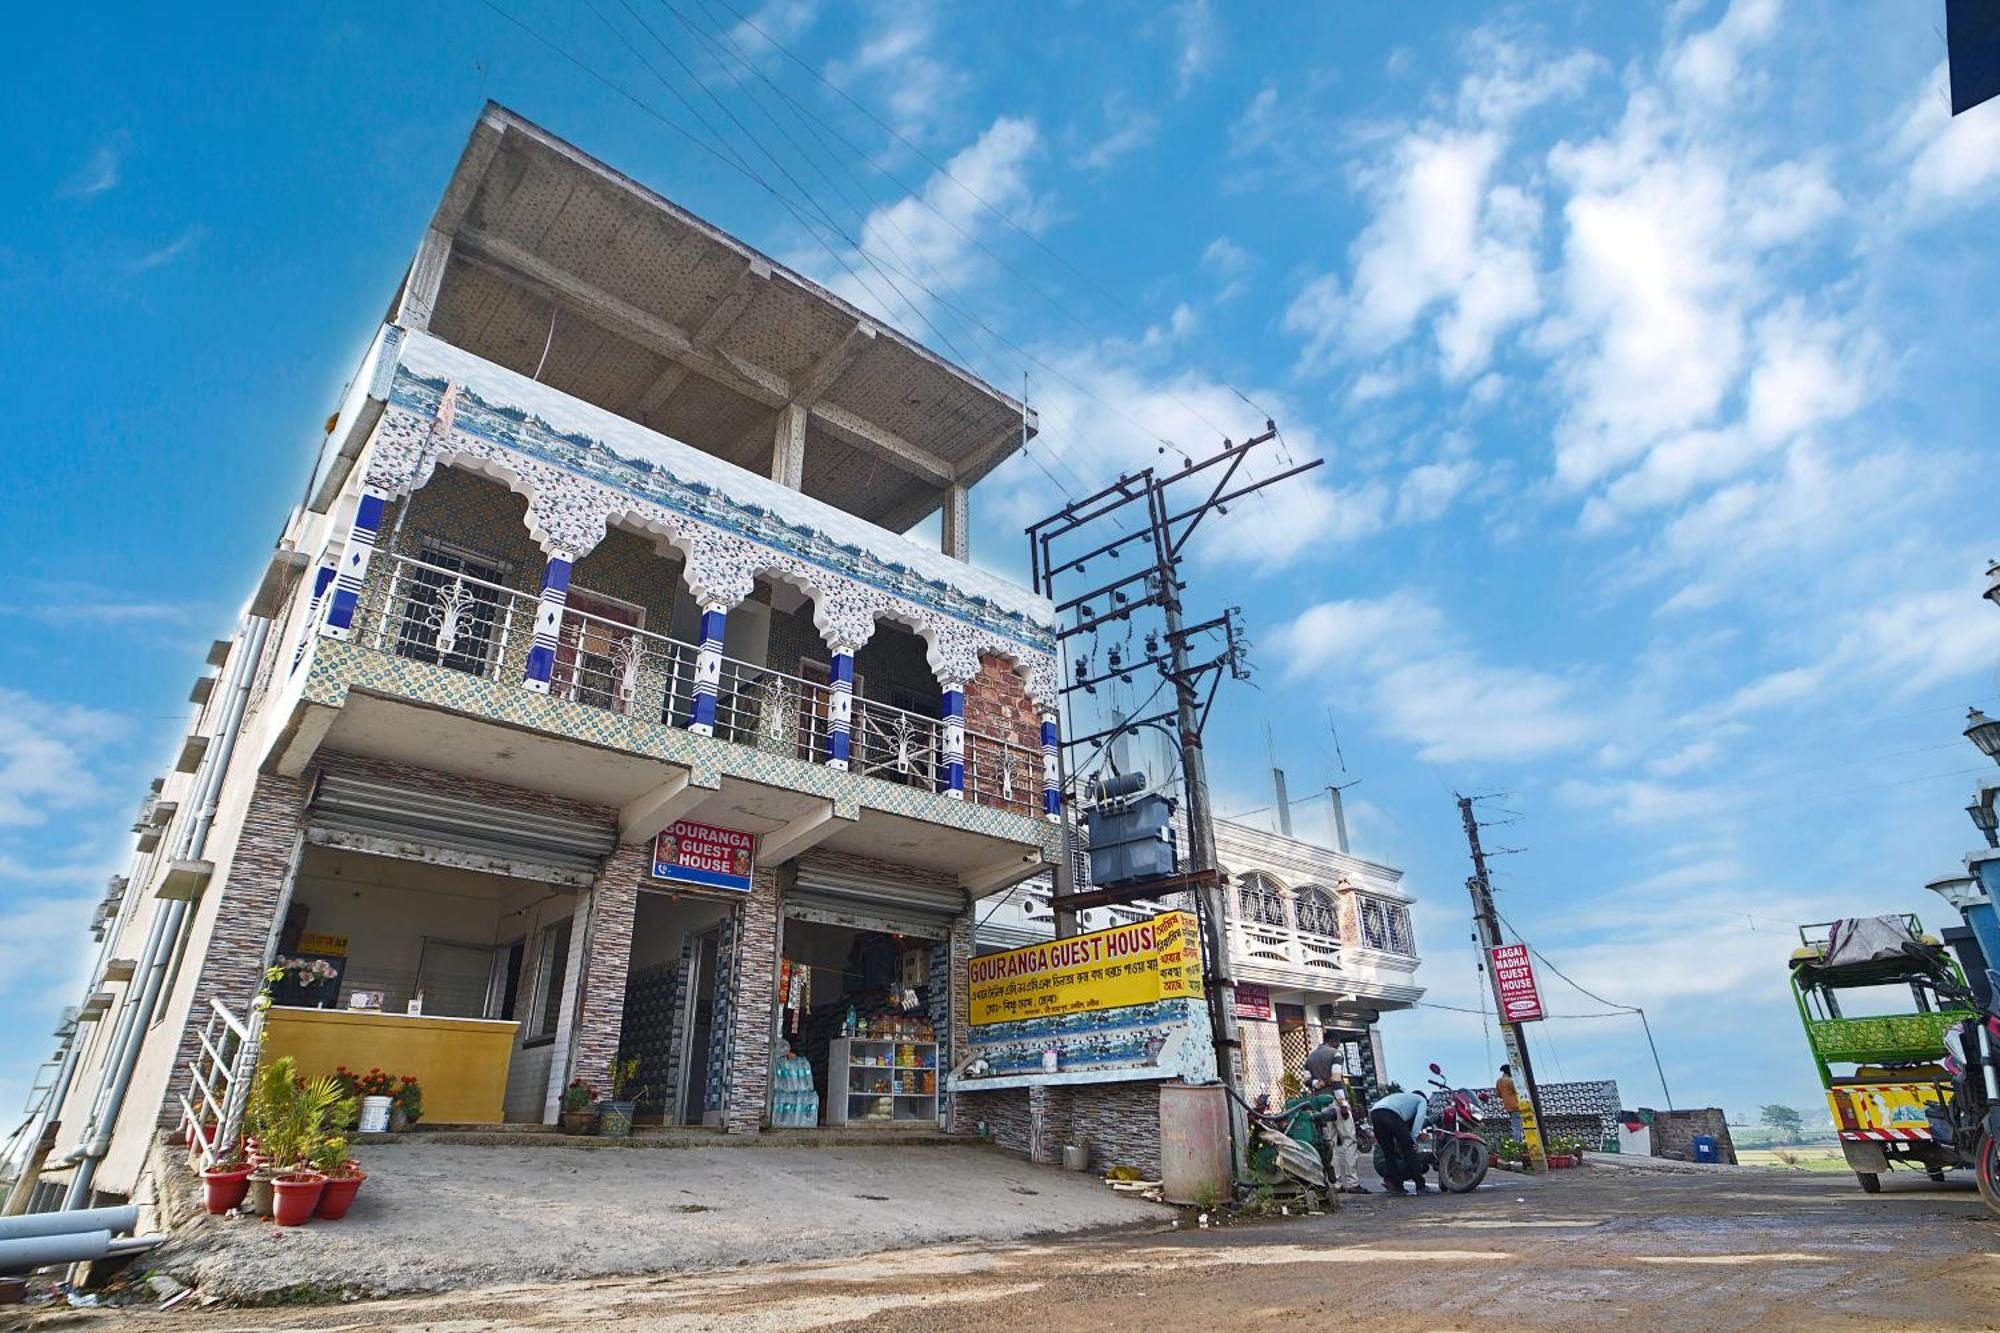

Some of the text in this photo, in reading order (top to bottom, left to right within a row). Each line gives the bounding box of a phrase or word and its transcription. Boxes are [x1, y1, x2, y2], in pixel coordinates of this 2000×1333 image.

[665, 824, 750, 848] GOURANGA
[682, 840, 731, 859] GUEST
[679, 854, 730, 873] HOUSE
[970, 947, 1048, 983] GOURANGA
[1051, 936, 1102, 968] GUEST
[1497, 947, 1522, 959] JAGAI
[1495, 956, 1529, 970] MADHAI
[1500, 967, 1529, 980] GUEST
[1502, 978, 1532, 991] HOUSE
